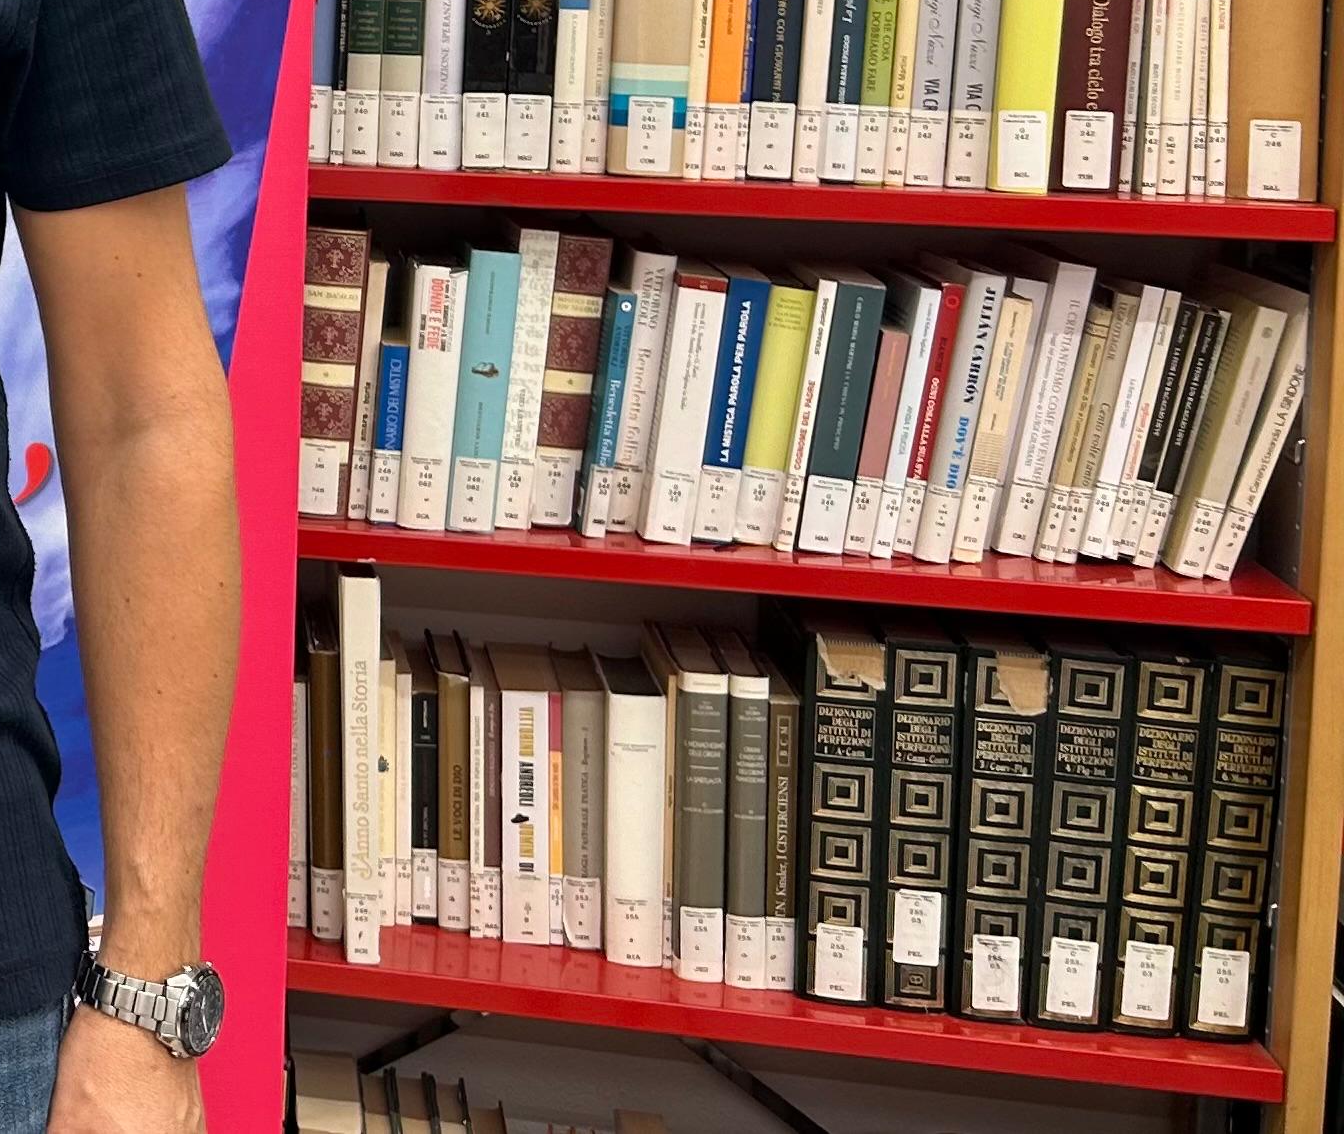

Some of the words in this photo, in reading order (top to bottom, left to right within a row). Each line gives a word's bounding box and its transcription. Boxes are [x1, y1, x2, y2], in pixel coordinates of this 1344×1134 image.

[1090, 47, 1107, 64] tra
[924, 78, 940, 96] VIA
[966, 84, 983, 101] VIA
[1089, 67, 1104, 101] cielo
[649, 268, 665, 330] VITTORINO
[737, 301, 752, 343] PAROLA
[734, 345, 744, 365] PER
[727, 366, 742, 411] PAROLA
[1280, 363, 1306, 414] SINDONE
[722, 412, 736, 450] MISTICA
[720, 452, 729, 463] LA
[946, 464, 961, 490] DIO
[819, 707, 872, 719] DIZIONARIO
[832, 718, 858, 726] DEGLI
[353, 718, 369, 756] nella
[818, 735, 872, 747] PERFEZIONE
[819, 725, 859, 737] ISTITUTI
[861, 729, 871, 737] DI
[1139, 728, 1195, 742] DIZIONARIO
[352, 761, 370, 809] Santo
[777, 777, 789, 853] CISTERCIENSI
